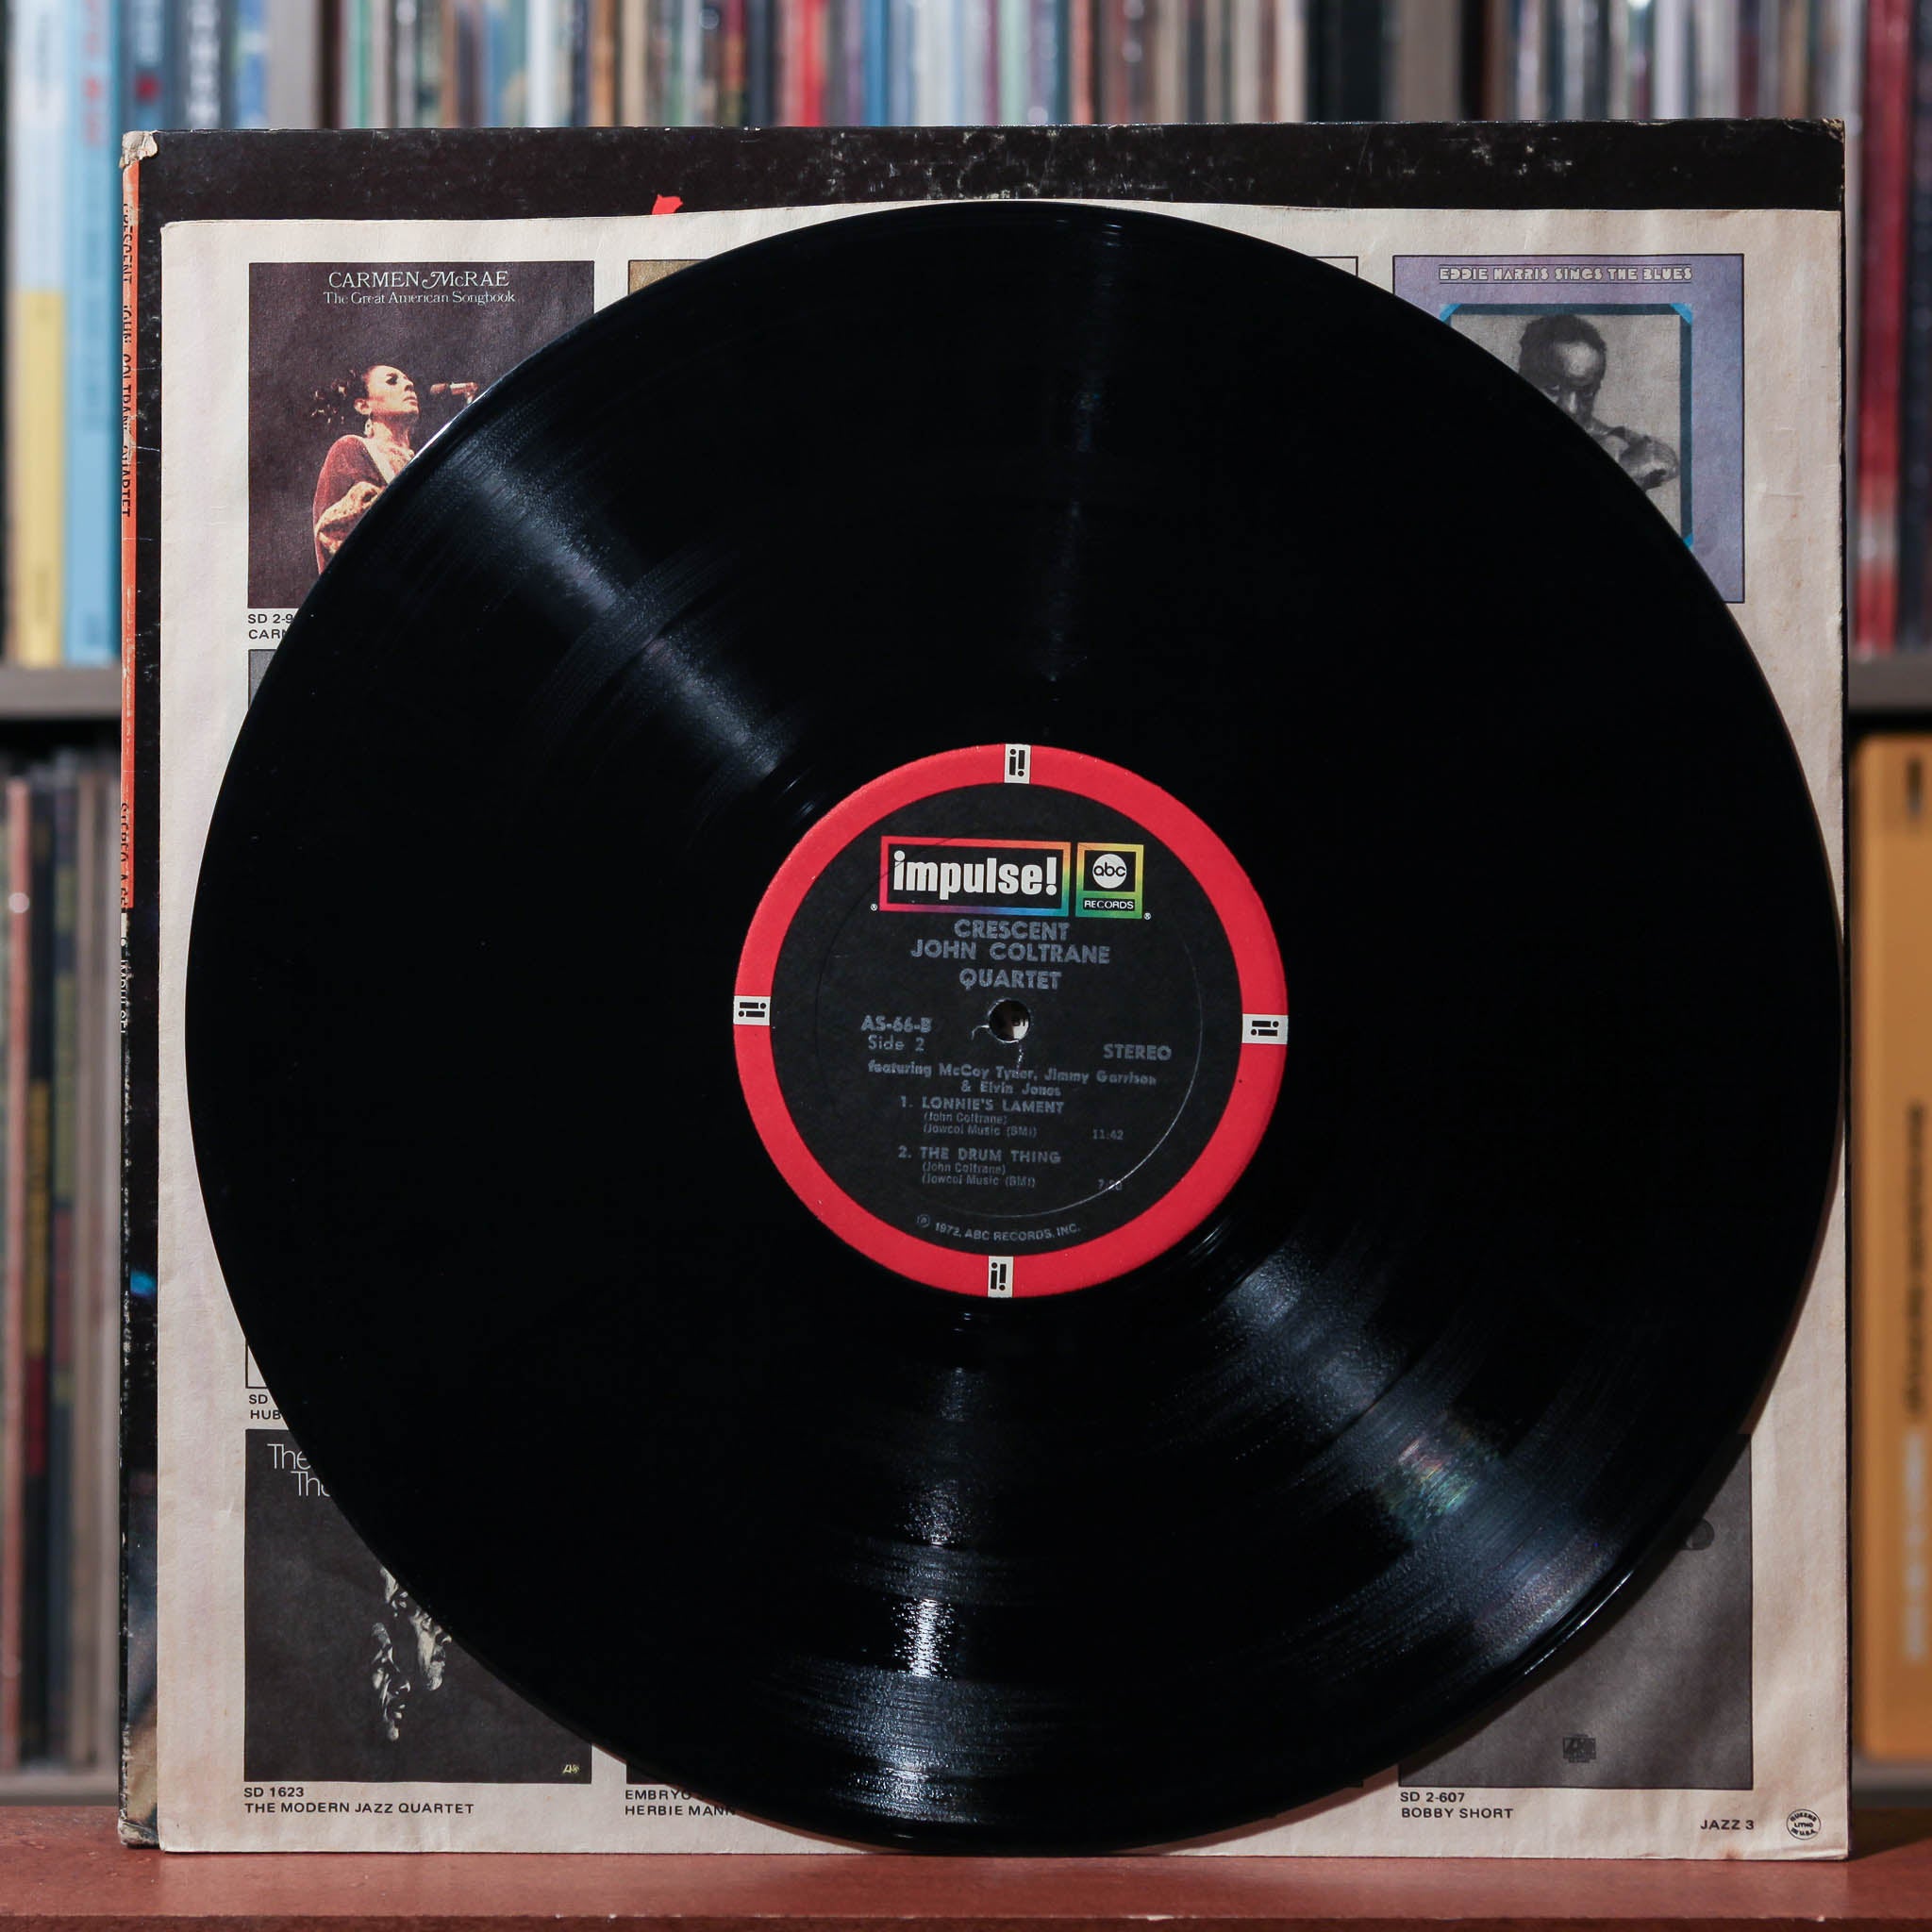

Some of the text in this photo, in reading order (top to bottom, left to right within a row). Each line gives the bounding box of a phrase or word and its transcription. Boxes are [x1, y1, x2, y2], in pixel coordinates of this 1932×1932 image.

[328, 270, 510, 290] CARMEN McRAE
[1439, 266, 1693, 281] EDDIE HARRIS SINGS THE BLUES
[324, 291, 516, 307] The Great American Songbook
[247, 613, 268, 625] SD
[892, 850, 1058, 900] impulse!
[1093, 861, 1126, 877] abc
[1084, 900, 1134, 909] RECORDS
[954, 919, 1070, 941] CRESCENT
[910, 939, 1111, 964] JOHN COLTRANE
[959, 967, 1063, 991] QUARTET
[860, 1014, 933, 1033] AS-66-B
[867, 1034, 924, 1052] Side 2
[1103, 1043, 1173, 1061] STEREO
[867, 1059, 933, 1077] featuring
[939, 1063, 991, 1080] McCoy
[1043, 1068, 1090, 1086] Jimmy
[1096, 1070, 1158, 1087] Garrison
[960, 1080, 1062, 1097] & Elvin Jones
[900, 1096, 1065, 1115] 1. LONNIE'S LAMENT
[967, 1124, 1002, 1137] Music
[898, 1145, 1062, 1164] 2. THE DRUM THING
[966, 1175, 1000, 1187] Music
[964, 1229, 990, 1241] ABC
[248, 1394, 268, 1405] SD
[267, 1443, 310, 1470] The
[243, 1787, 305, 1798] SD 1623
[1400, 1791, 1465, 1803] SD 2-607
[244, 1802, 475, 1814] THE MODERN JAZZ QUARTET
[625, 1805, 683, 1816] HERBIE
[1401, 1807, 1513, 1819] BOBBY SHORT
[1700, 1819, 1755, 1830] JAZZ 3
